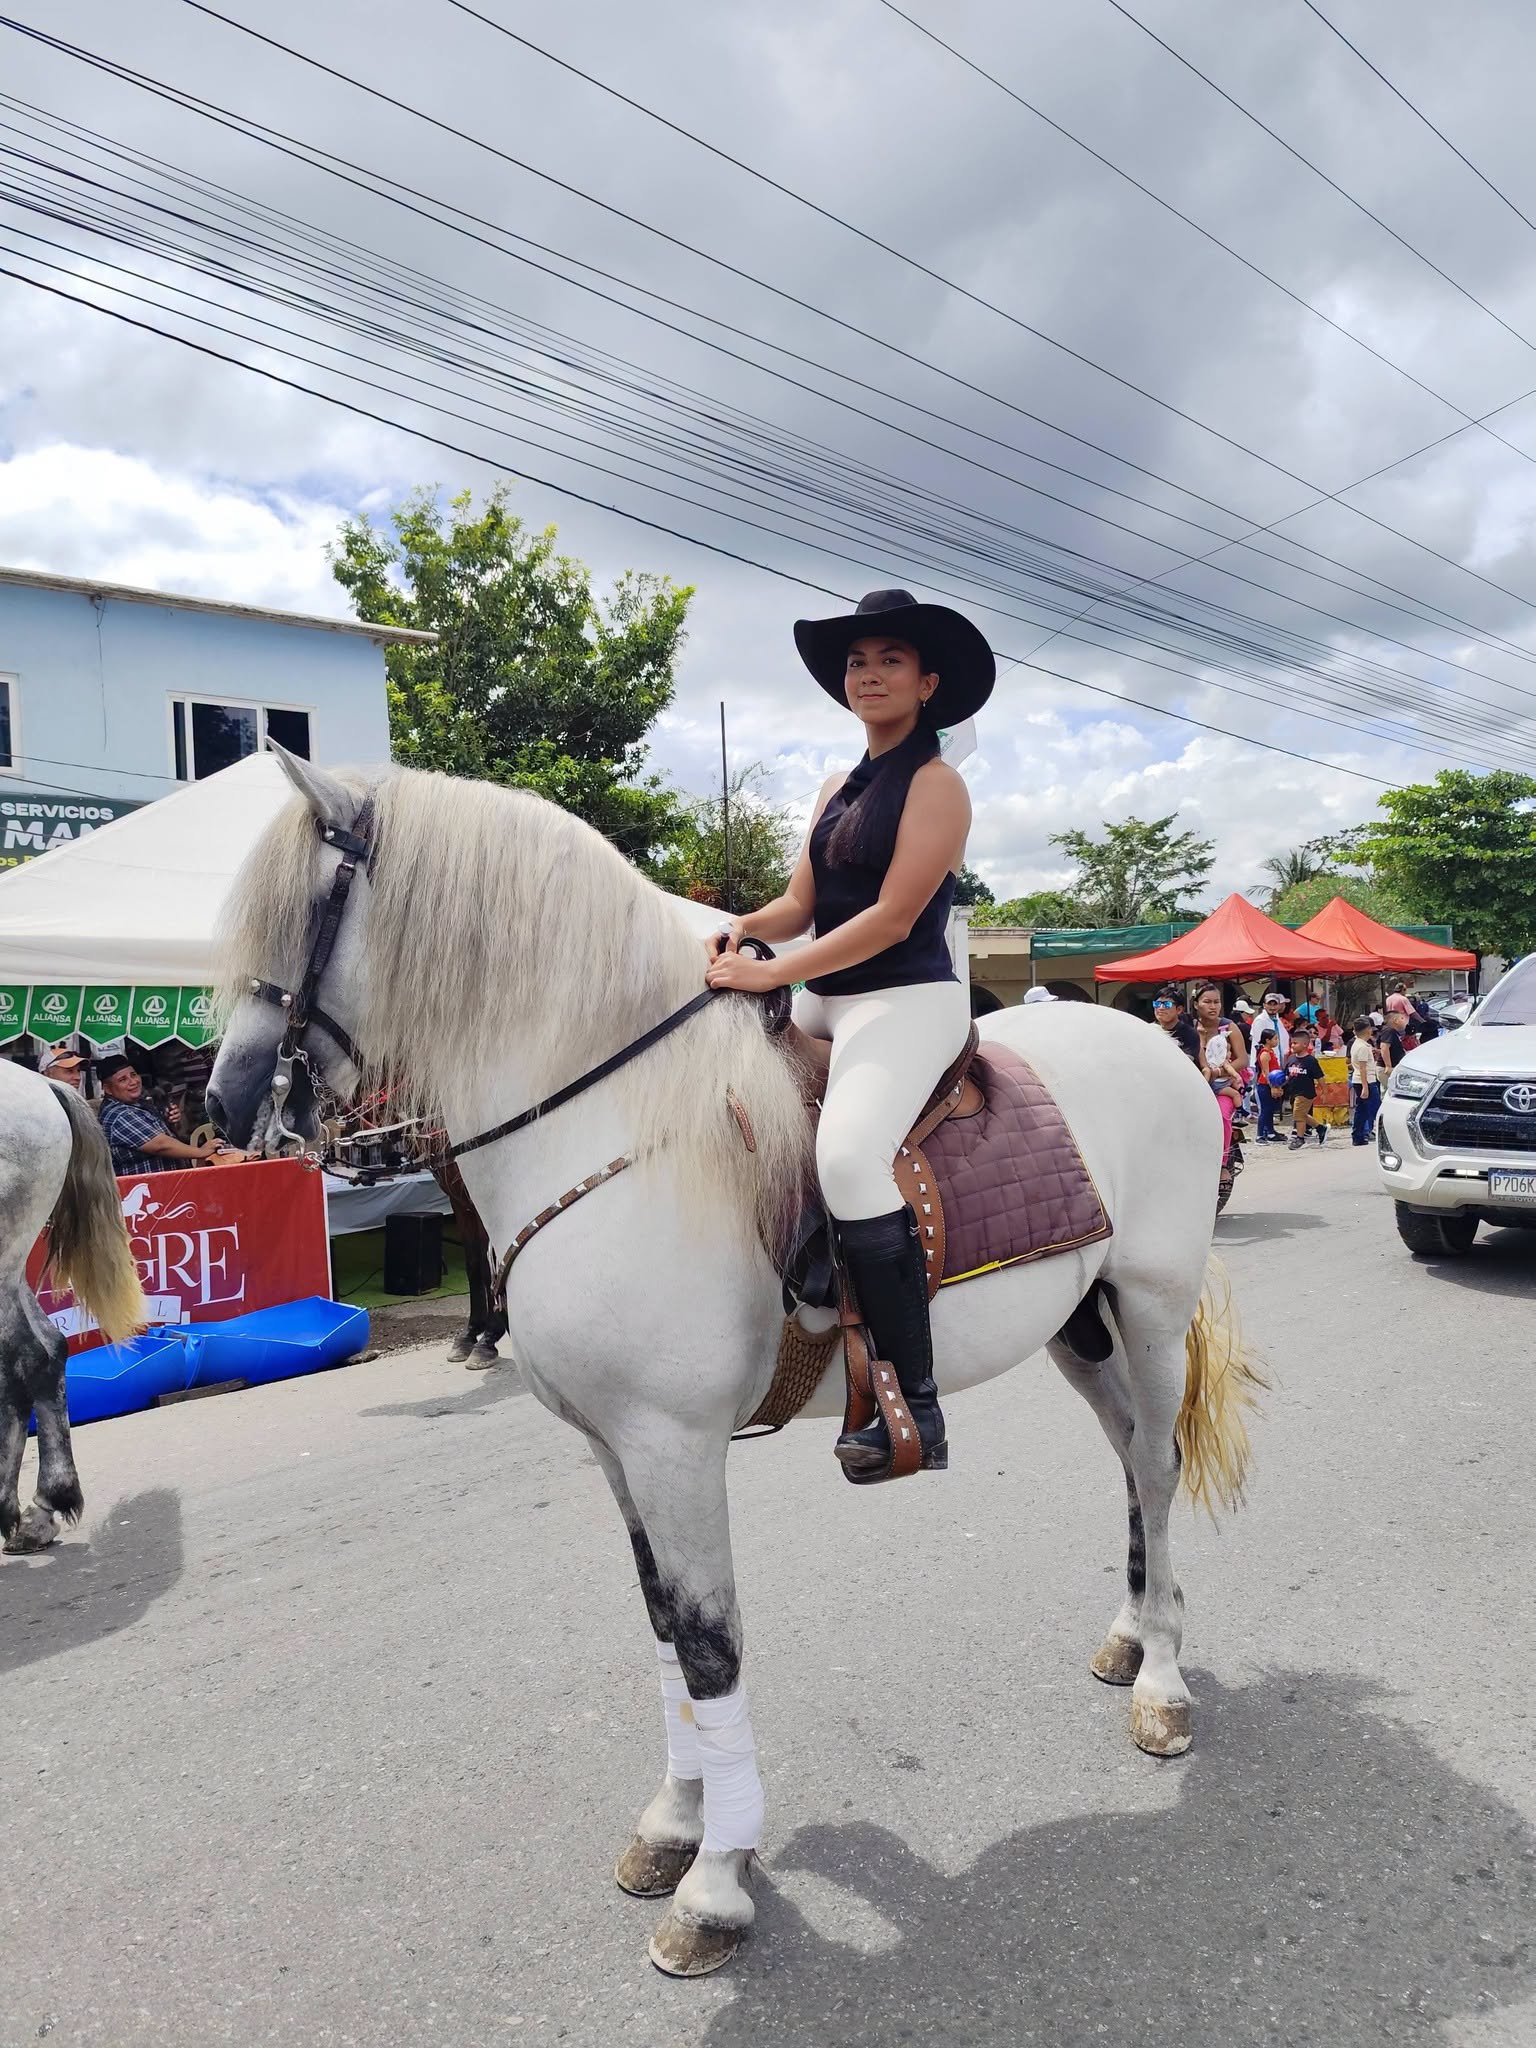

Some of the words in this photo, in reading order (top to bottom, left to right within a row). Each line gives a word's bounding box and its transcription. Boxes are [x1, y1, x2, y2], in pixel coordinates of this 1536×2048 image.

[0, 802, 114, 821] SERVICIOS
[33, 1013, 71, 1023] ALIANSA
[85, 1014, 123, 1023] ALIANSA
[134, 1016, 170, 1025] ALIANSA
[1494, 1176, 1535, 1193] P706K
